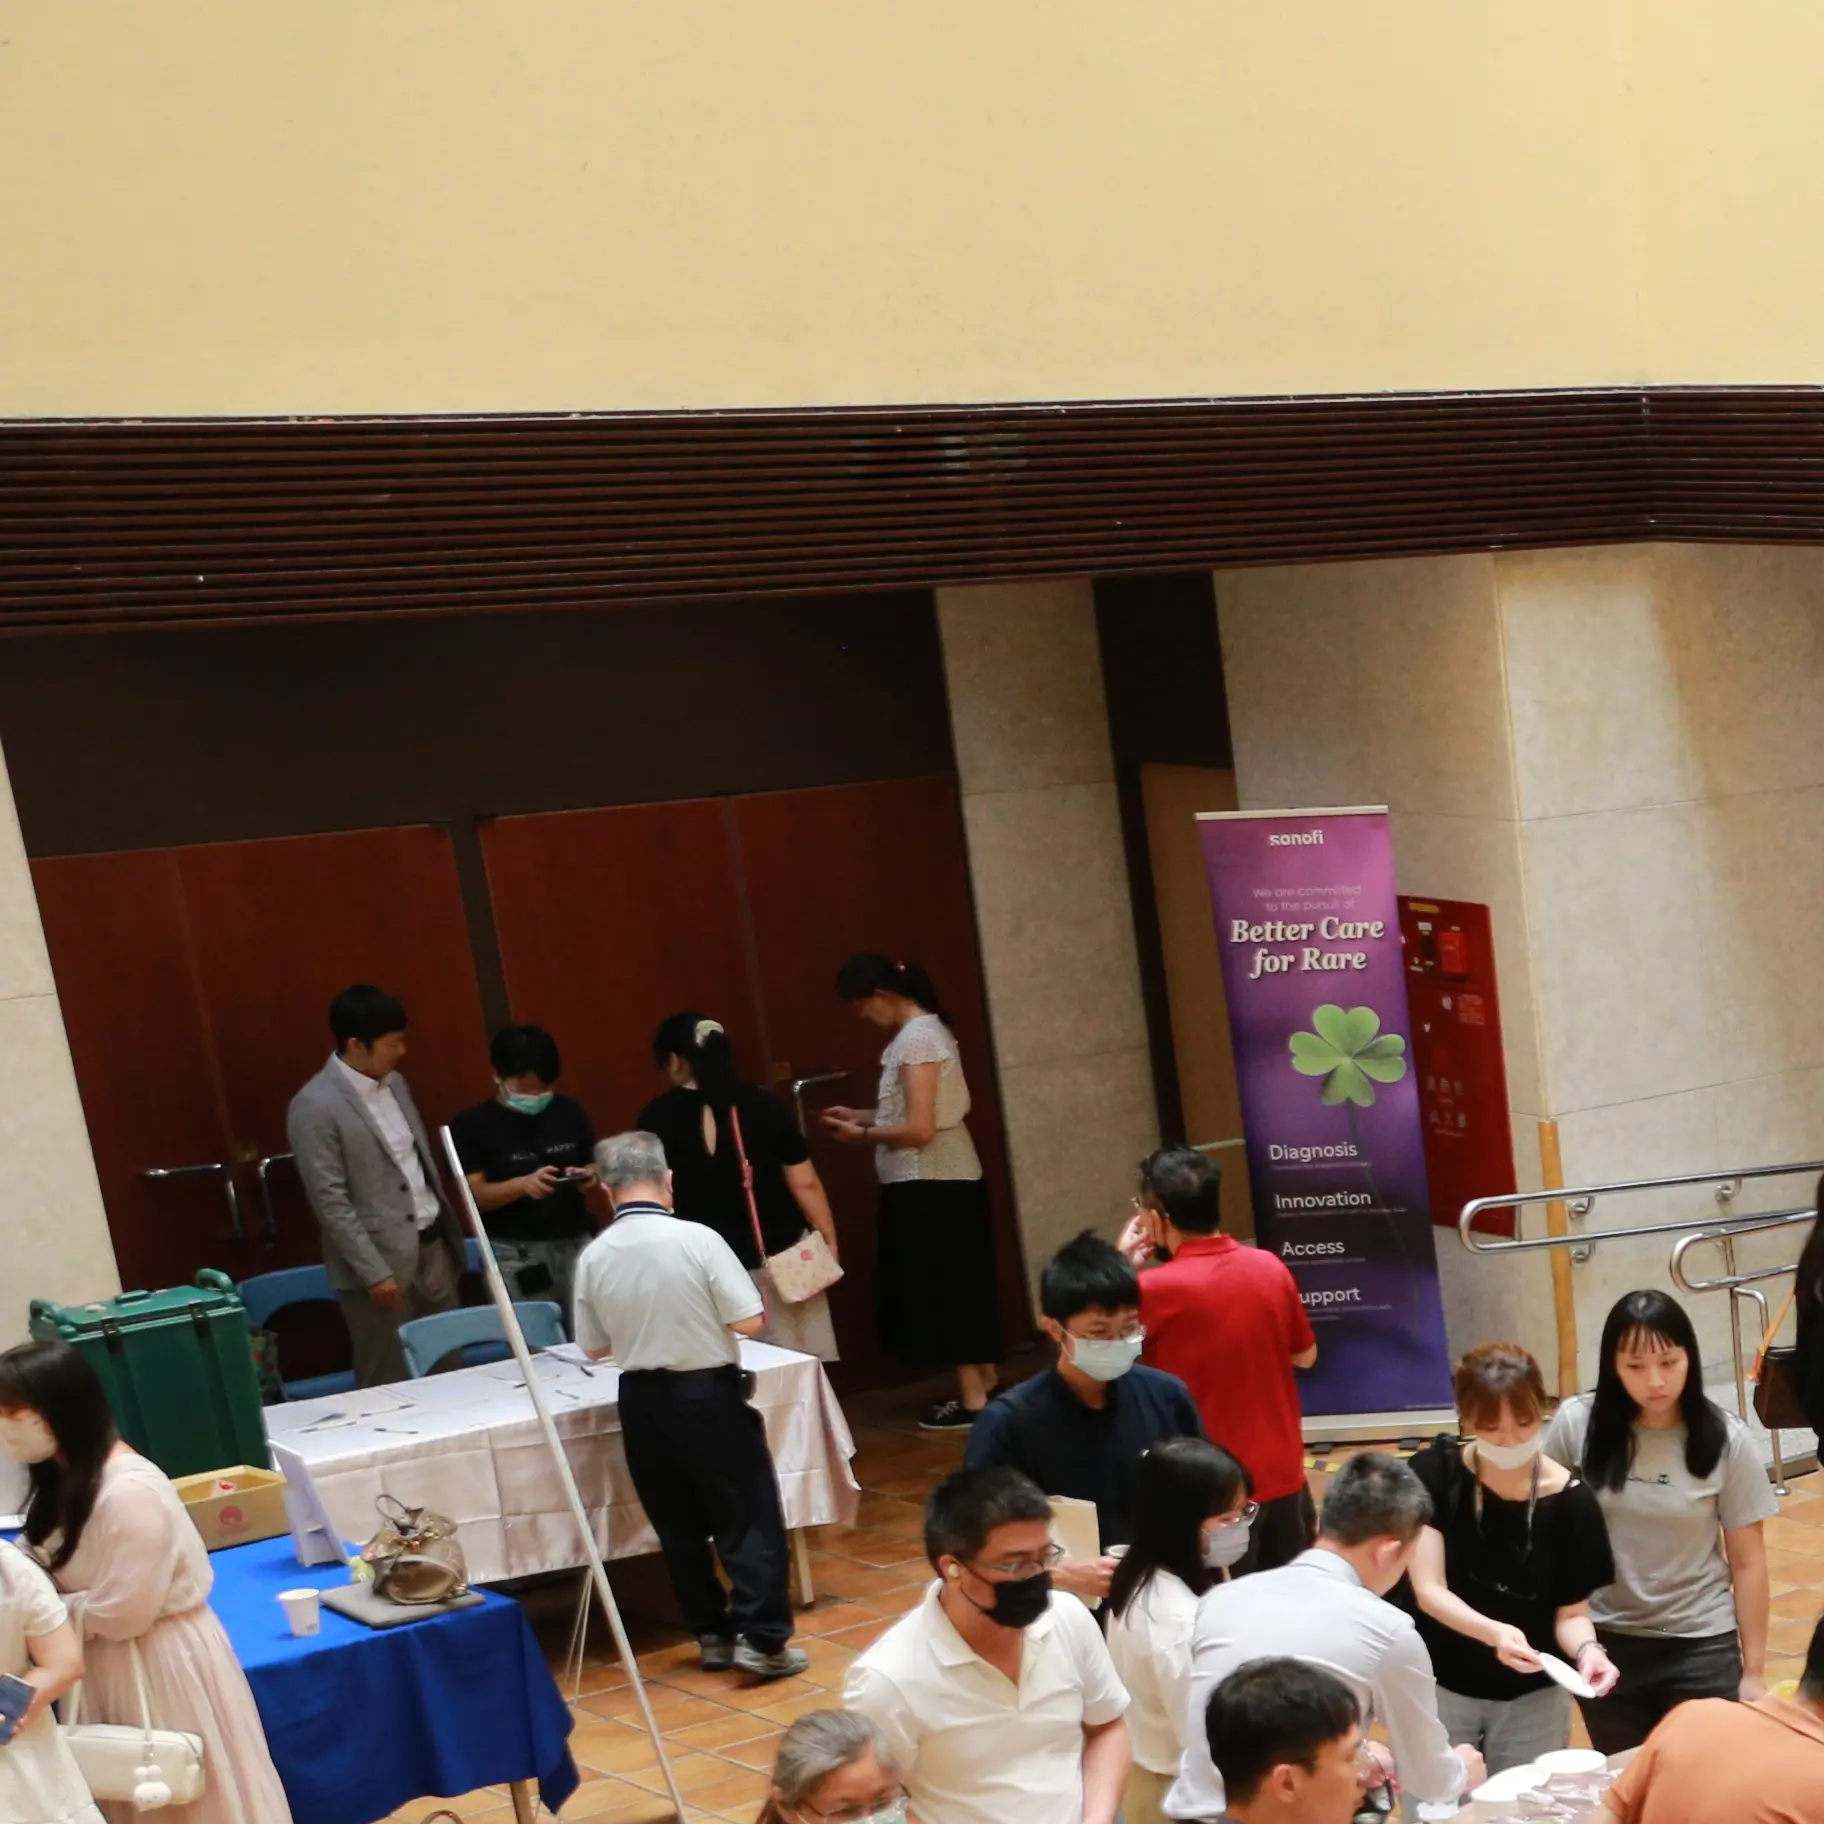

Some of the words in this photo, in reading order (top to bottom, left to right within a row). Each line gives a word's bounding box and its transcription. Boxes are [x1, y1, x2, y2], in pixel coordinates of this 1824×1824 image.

[1269, 830, 1324, 846] sanofi
[1230, 919, 1314, 943] Better
[1321, 916, 1384, 940] Care
[1249, 948, 1295, 979] for
[1301, 947, 1367, 971] Rare
[1269, 1142, 1358, 1162] Diagnosis
[1275, 1191, 1371, 1209] Innovation
[1282, 1241, 1345, 1256] Access
[1300, 1287, 1361, 1306] upport
